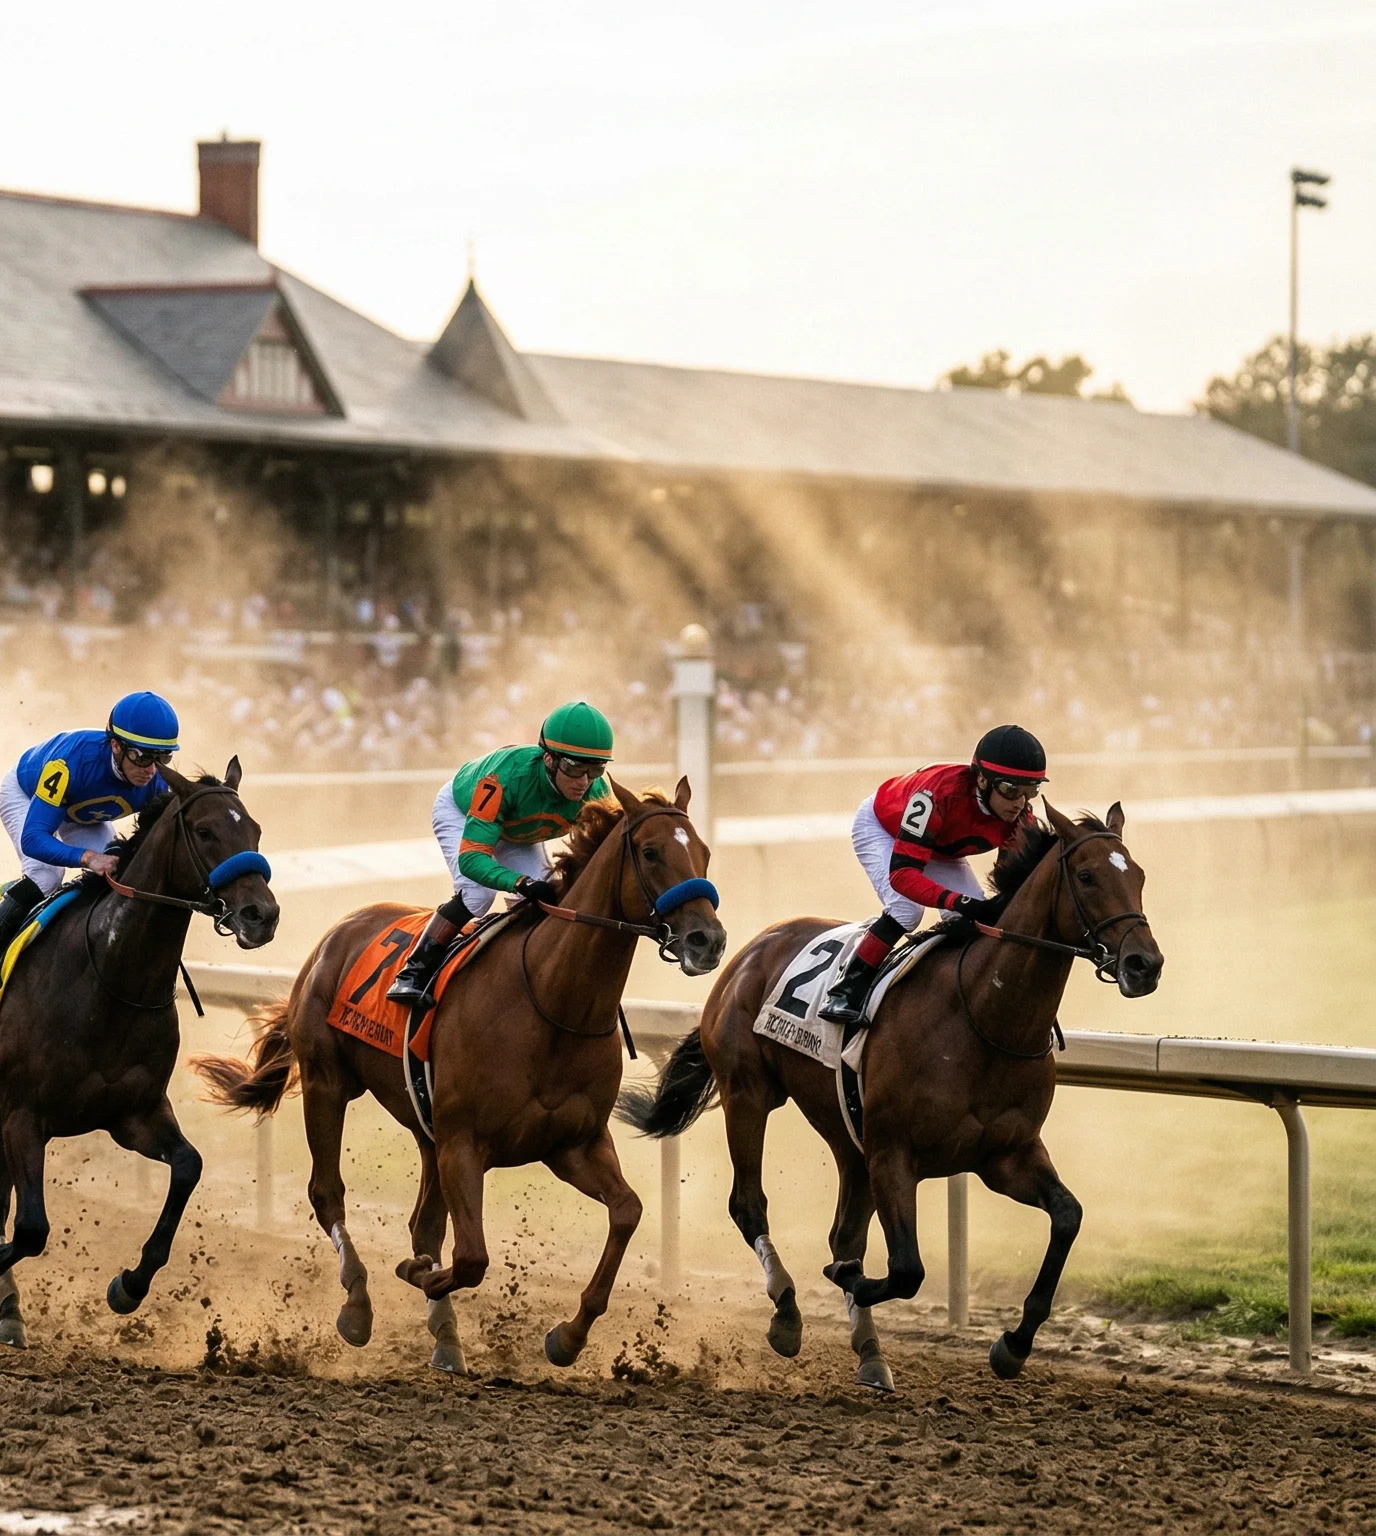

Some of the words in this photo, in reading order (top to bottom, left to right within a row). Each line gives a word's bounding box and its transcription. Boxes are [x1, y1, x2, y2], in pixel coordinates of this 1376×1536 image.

[43, 771, 63, 798] 4
[477, 783, 497, 811] 7
[906, 800, 926, 829] 2
[348, 928, 415, 1005] 7
[774, 939, 845, 1019] 2
